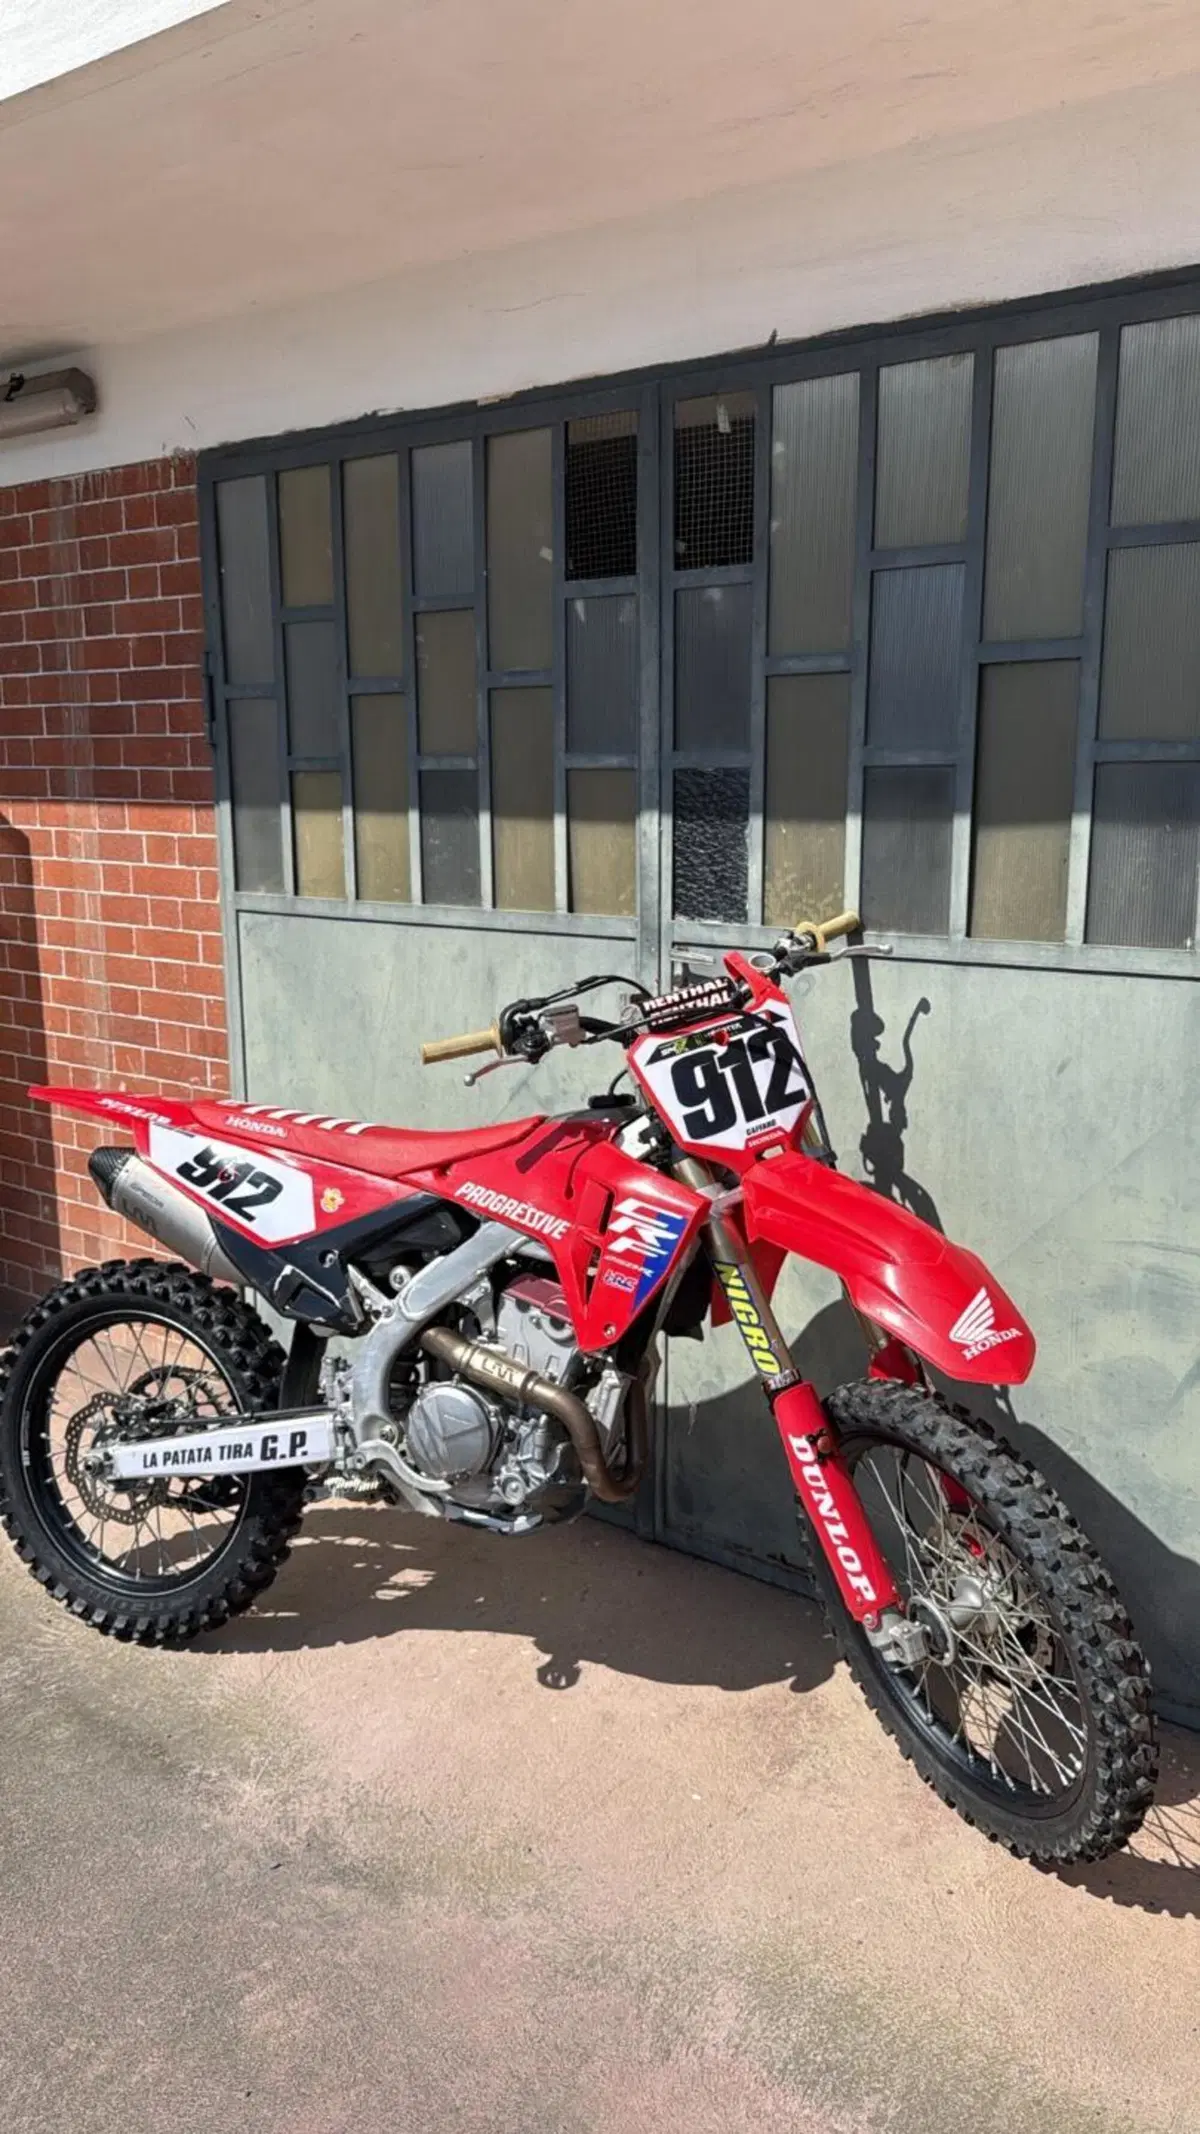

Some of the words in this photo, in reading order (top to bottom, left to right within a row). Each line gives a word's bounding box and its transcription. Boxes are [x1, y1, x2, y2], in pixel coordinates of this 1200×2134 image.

[643, 979, 728, 1011] RENTHAL
[671, 1026, 807, 1140] 912
[225, 1115, 286, 1138] HONDA
[176, 1145, 283, 1222] 912
[454, 1181, 572, 1240] PROGRESSIVE
[961, 1327, 1024, 1361] HONDA
[143, 1453, 158, 1469] LA
[162, 1446, 213, 1467] PATATA
[219, 1442, 254, 1461] TIRA
[260, 1430, 309, 1462] G.P.
[788, 1433, 877, 1603] DUNLOP
